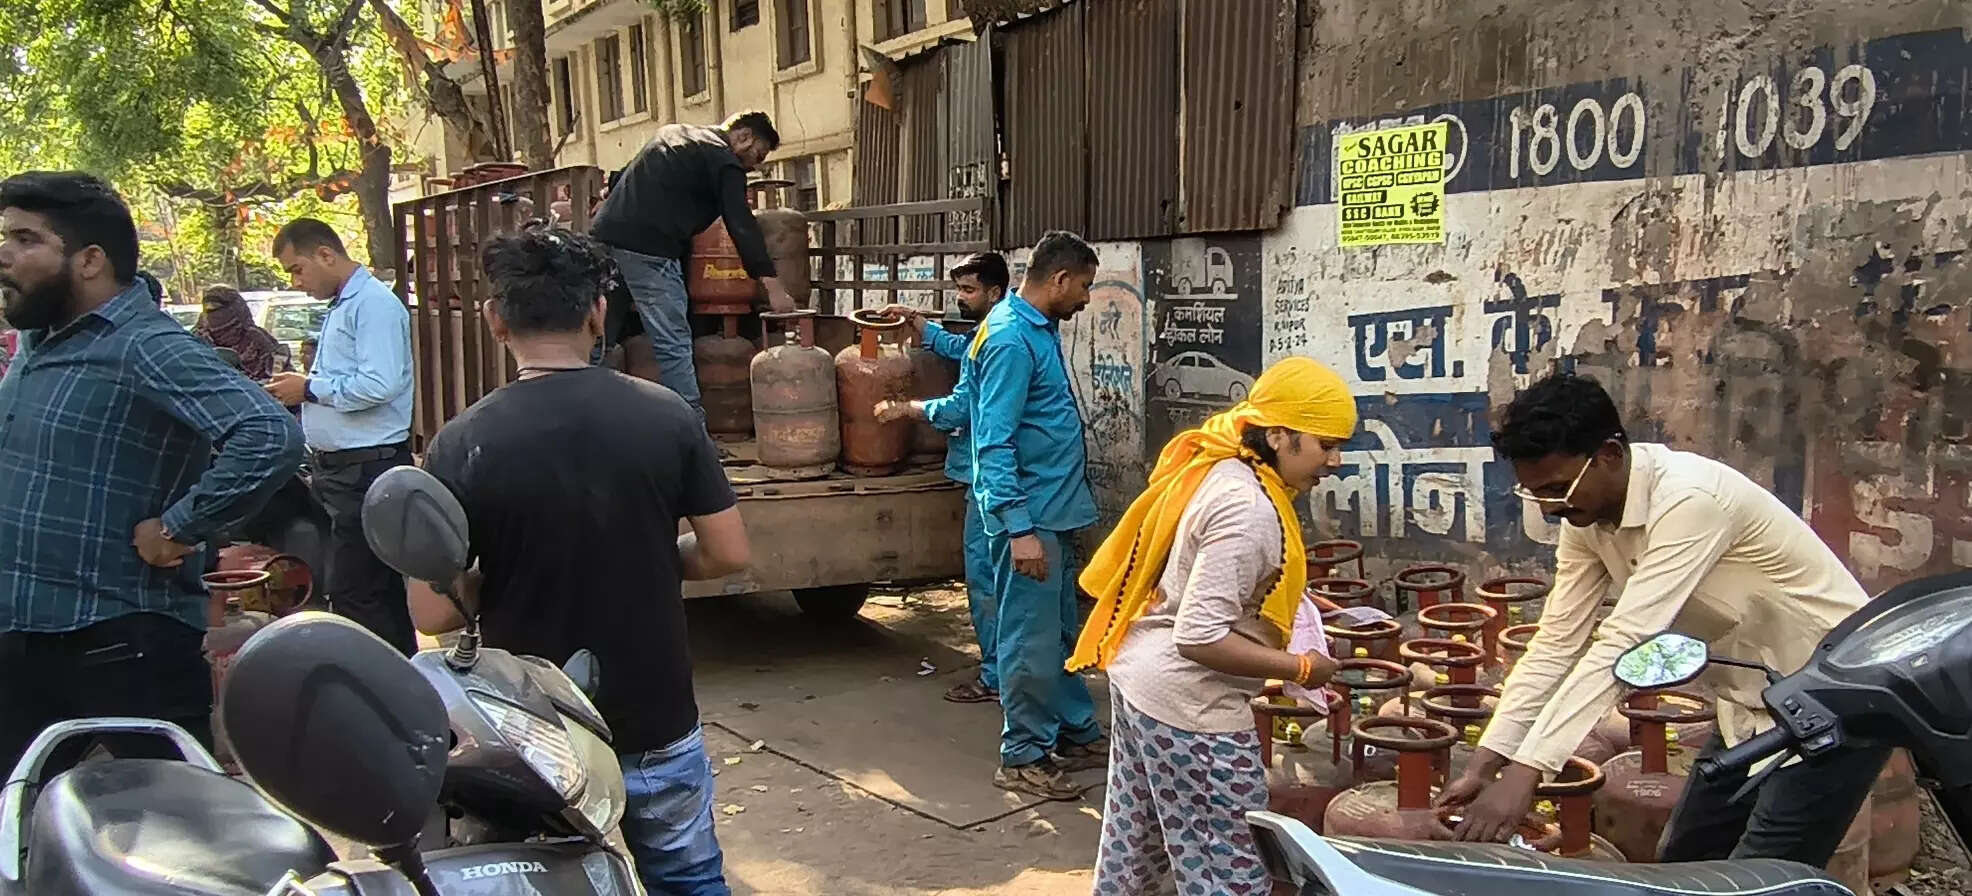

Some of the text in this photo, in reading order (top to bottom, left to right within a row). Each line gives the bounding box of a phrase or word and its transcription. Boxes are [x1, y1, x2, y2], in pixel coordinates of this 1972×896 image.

[1358, 129, 1437, 158] SAGAR
[1510, 92, 1646, 178] 1800
[1341, 151, 1443, 175] COACHING
[1345, 206, 1400, 219] SSC BANK
[1173, 301, 1226, 323] कमर्शियल
[1199, 322, 1224, 344] लोन
[1348, 305, 1464, 381] एस.
[461, 861, 549, 880] HONDA
